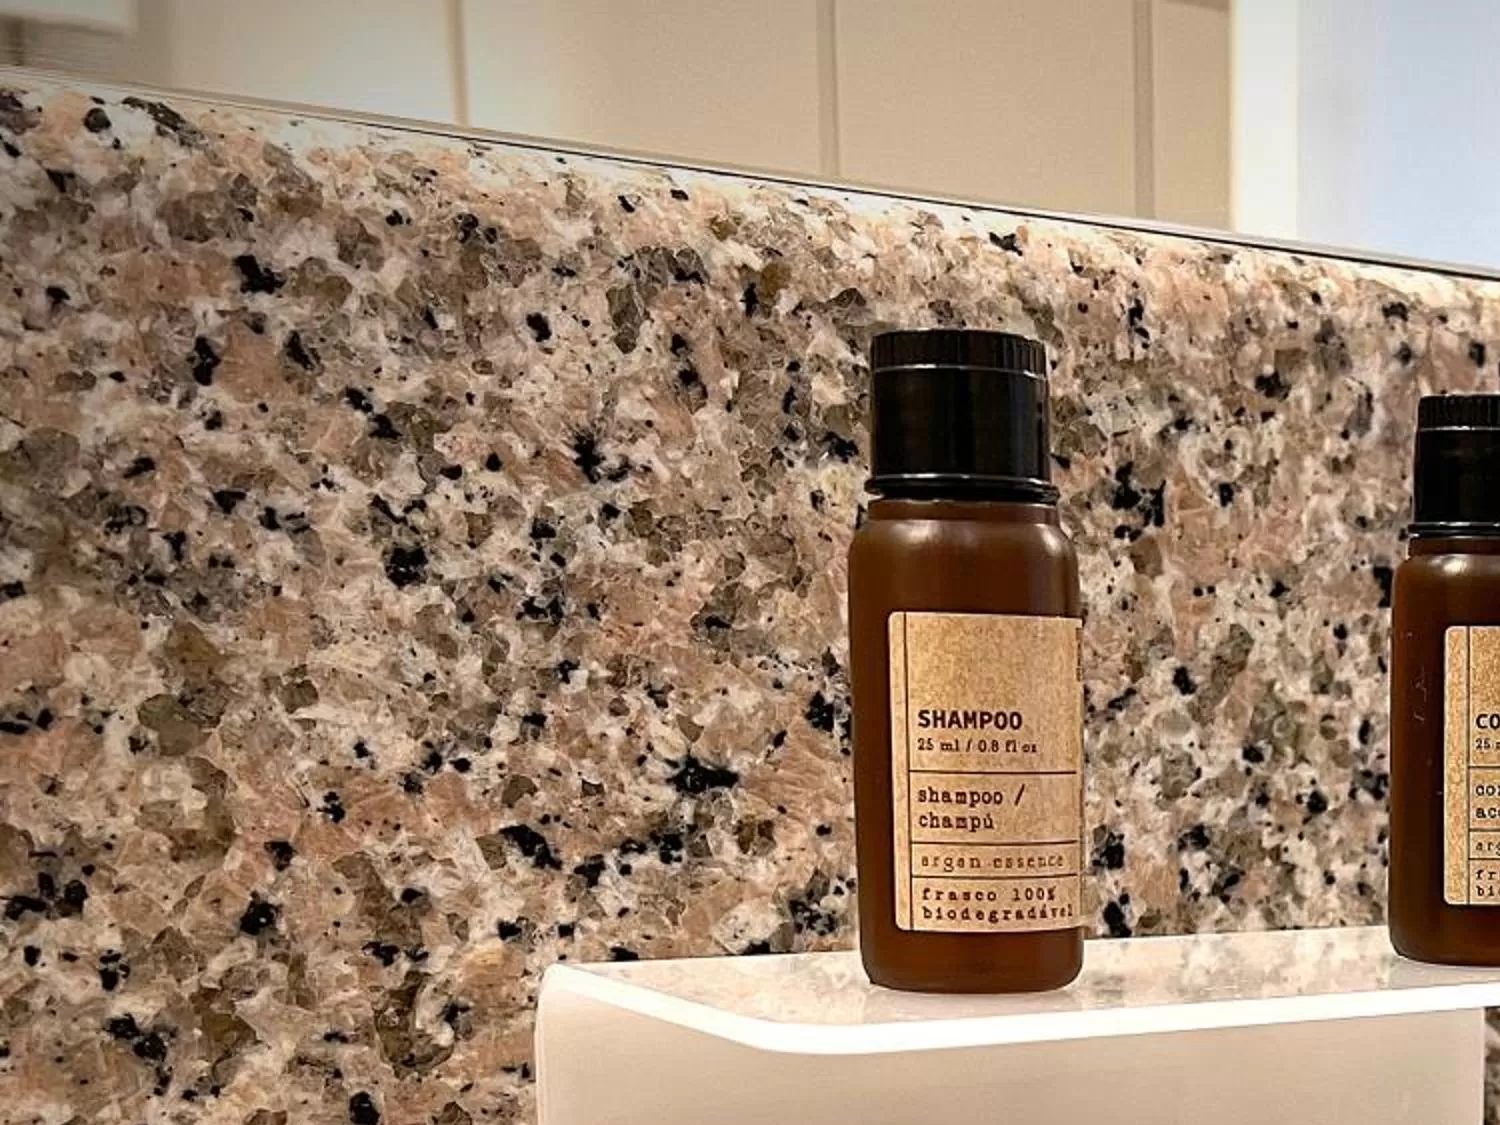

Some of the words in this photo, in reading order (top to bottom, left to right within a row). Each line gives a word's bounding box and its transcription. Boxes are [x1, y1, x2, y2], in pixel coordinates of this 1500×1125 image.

[918, 709, 1023, 730] SHAMPOO
[917, 737, 934, 751] 25
[940, 739, 960, 752] ml
[1005, 739, 1018, 752] fl
[1476, 738, 1490, 749] 25
[918, 787, 1003, 808] shampoo
[1014, 783, 1025, 806] /
[918, 812, 995, 832] champú
[921, 856, 981, 872] argan
[993, 855, 1064, 869] essence
[922, 888, 997, 901] frasco
[1013, 886, 1057, 901] 100%
[922, 904, 1073, 923] biodegradável
